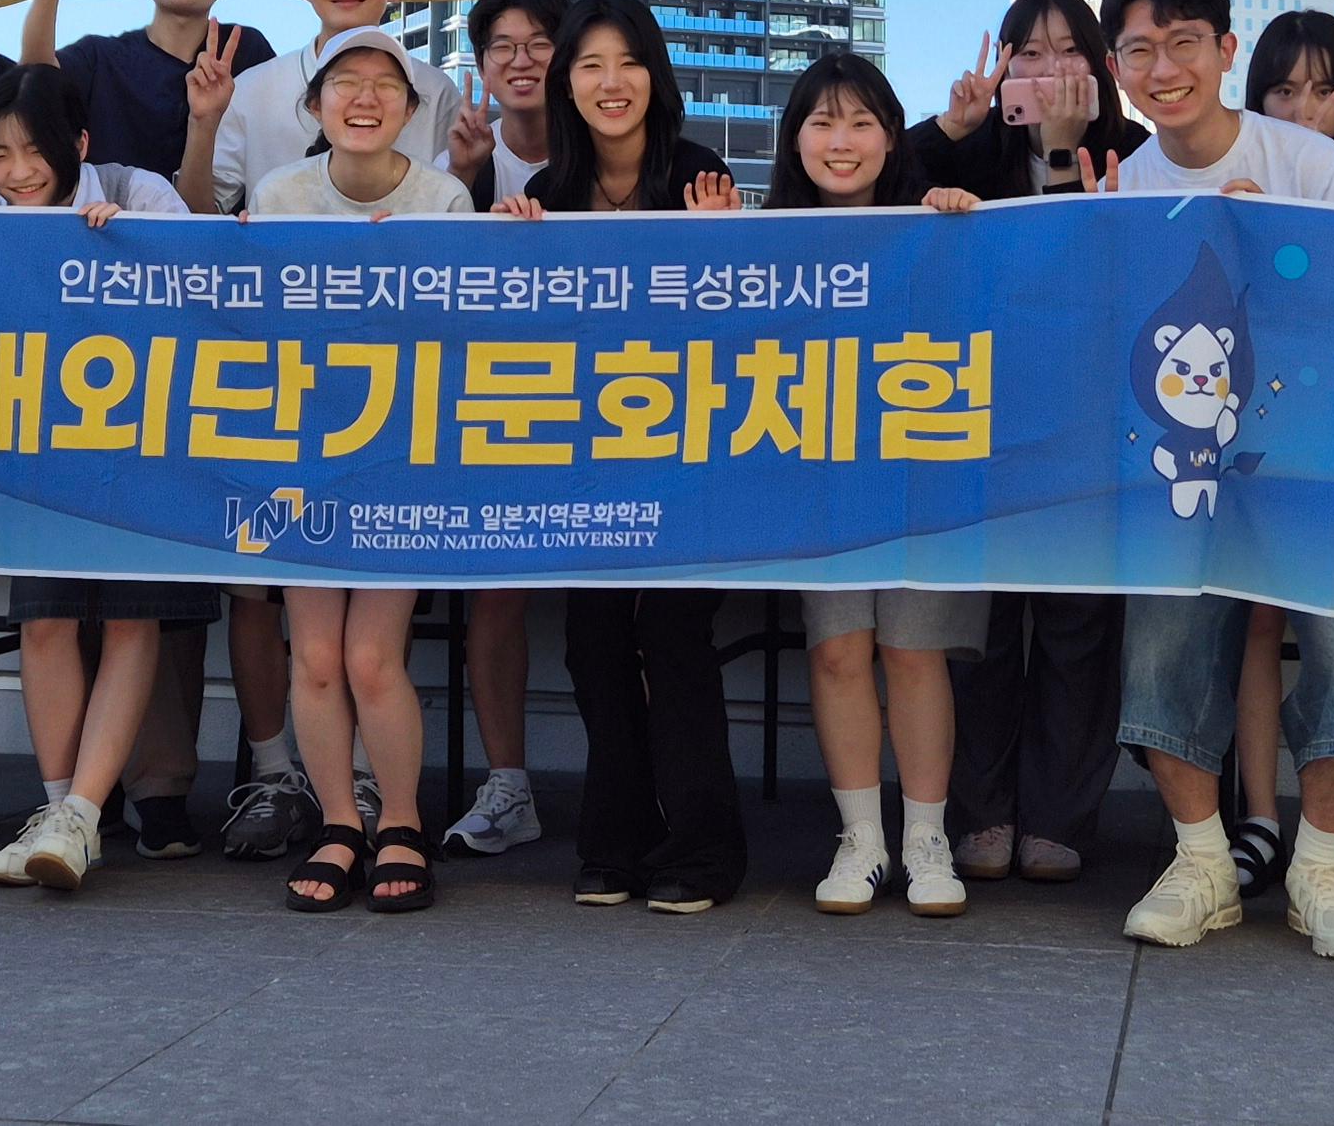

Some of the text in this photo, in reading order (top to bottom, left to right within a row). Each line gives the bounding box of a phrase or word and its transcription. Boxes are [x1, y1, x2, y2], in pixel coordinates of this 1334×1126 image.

[59, 258, 871, 313] 인천대학교 일본지역문화학과 특성화사업
[349, 501, 663, 531] 인천대학교 일본지역문화학과
[351, 531, 658, 550] INCHEON NATIONAL UNIVERSITY
